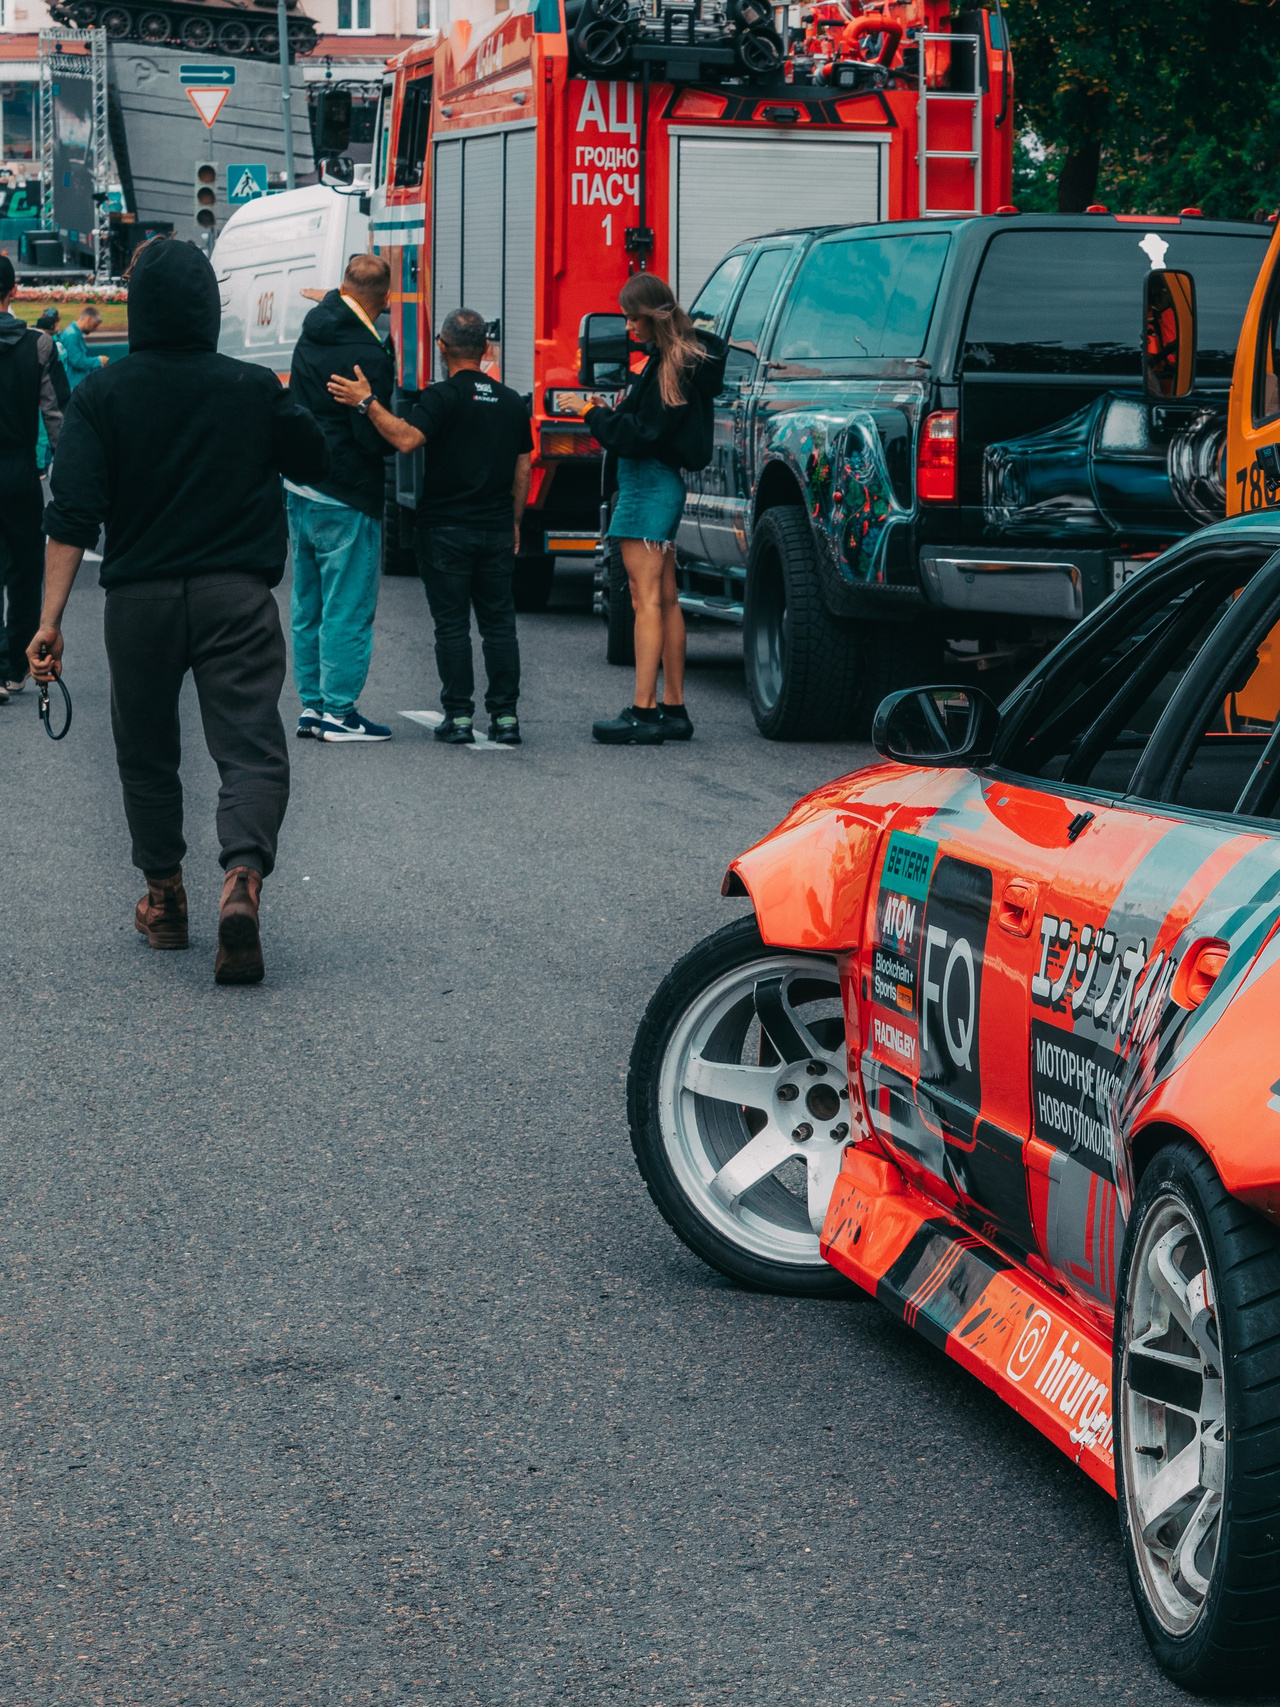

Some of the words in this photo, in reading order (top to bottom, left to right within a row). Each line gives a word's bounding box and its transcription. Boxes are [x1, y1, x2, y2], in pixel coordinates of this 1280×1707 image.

[576, 80, 637, 144] АЦ
[575, 147, 640, 171] ГРОДНО
[571, 173, 640, 206] ПАСЧ
[601, 213, 612, 246] 1
[257, 291, 274, 326] 103
[882, 896, 916, 943] ATOM
[875, 952, 910, 984] Blockchain
[874, 974, 897, 1001] Sports
[922, 924, 975, 1072] FQ
